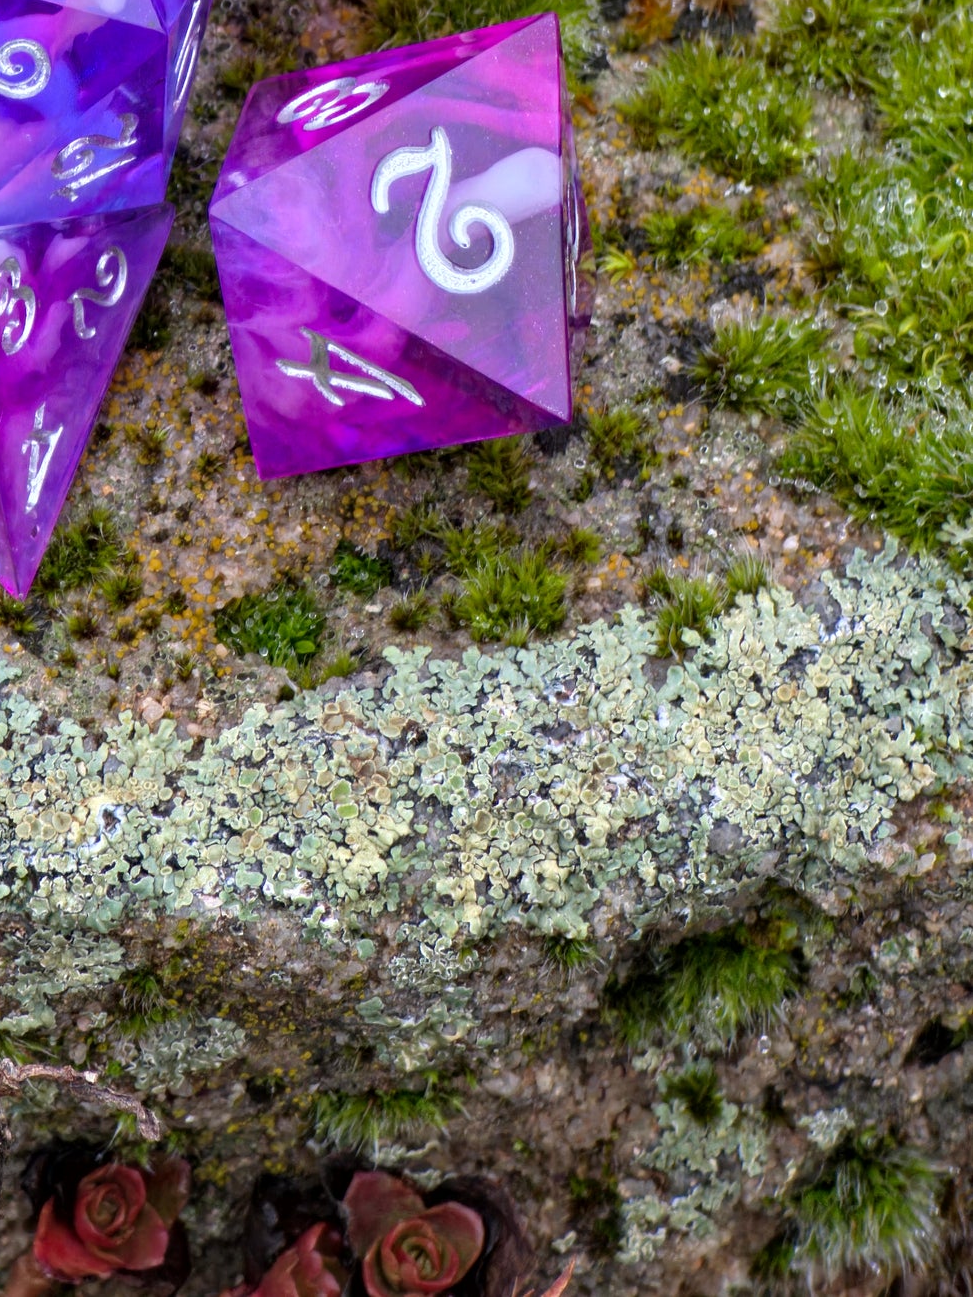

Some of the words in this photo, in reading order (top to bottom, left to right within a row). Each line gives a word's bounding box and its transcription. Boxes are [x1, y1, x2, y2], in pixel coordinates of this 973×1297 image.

[51, 113, 139, 202] 12
[371, 126, 515, 294] 2
[69, 245, 128, 340] 2
[276, 327, 426, 407] 4
[22, 402, 63, 514] 4
